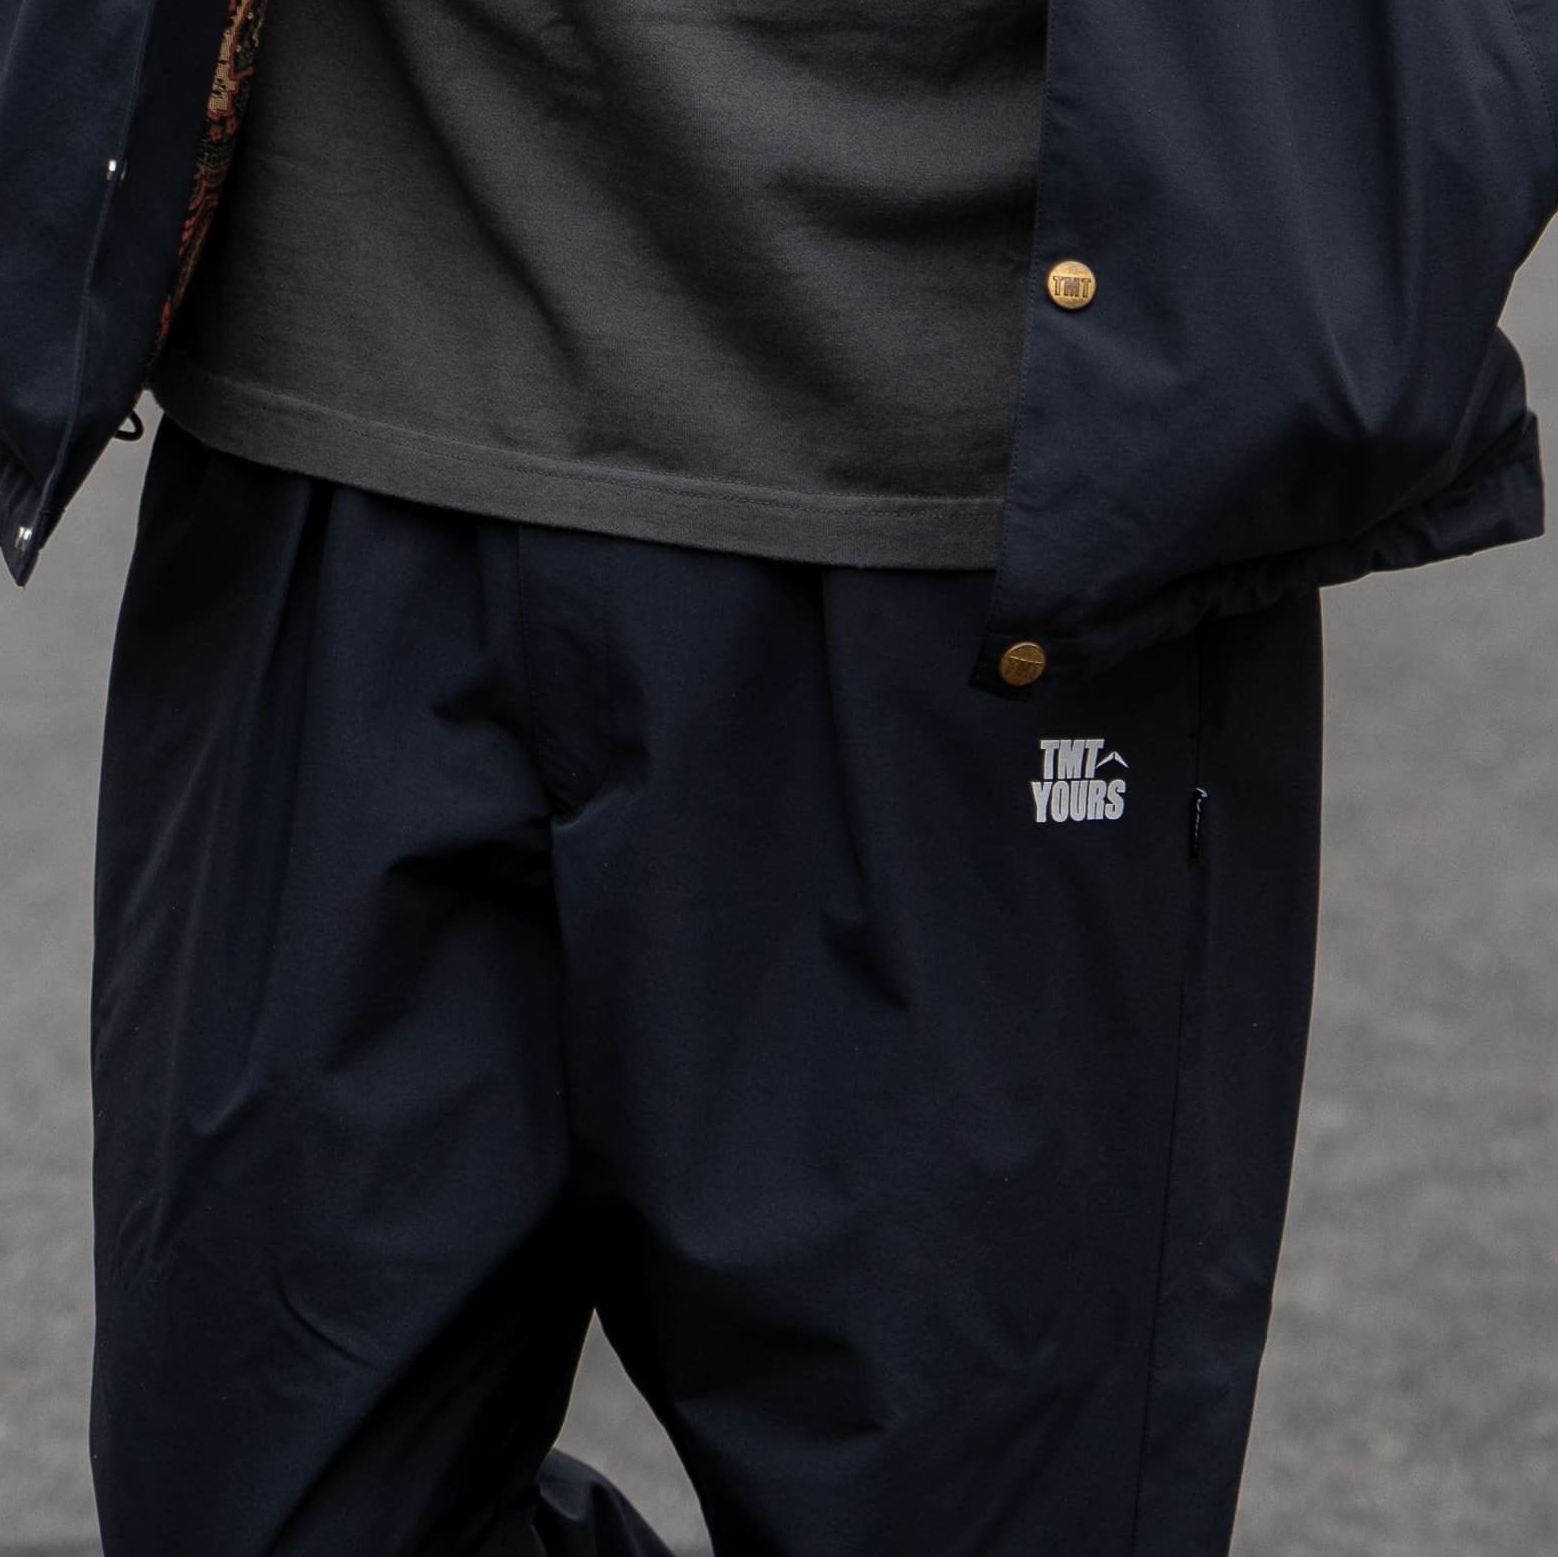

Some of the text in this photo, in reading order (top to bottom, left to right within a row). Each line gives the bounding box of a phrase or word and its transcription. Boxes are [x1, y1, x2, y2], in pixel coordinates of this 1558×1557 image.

[1052, 275, 1092, 299] TMT
[1040, 739, 1104, 780] TMT
[1030, 779, 1126, 823] YOURS
